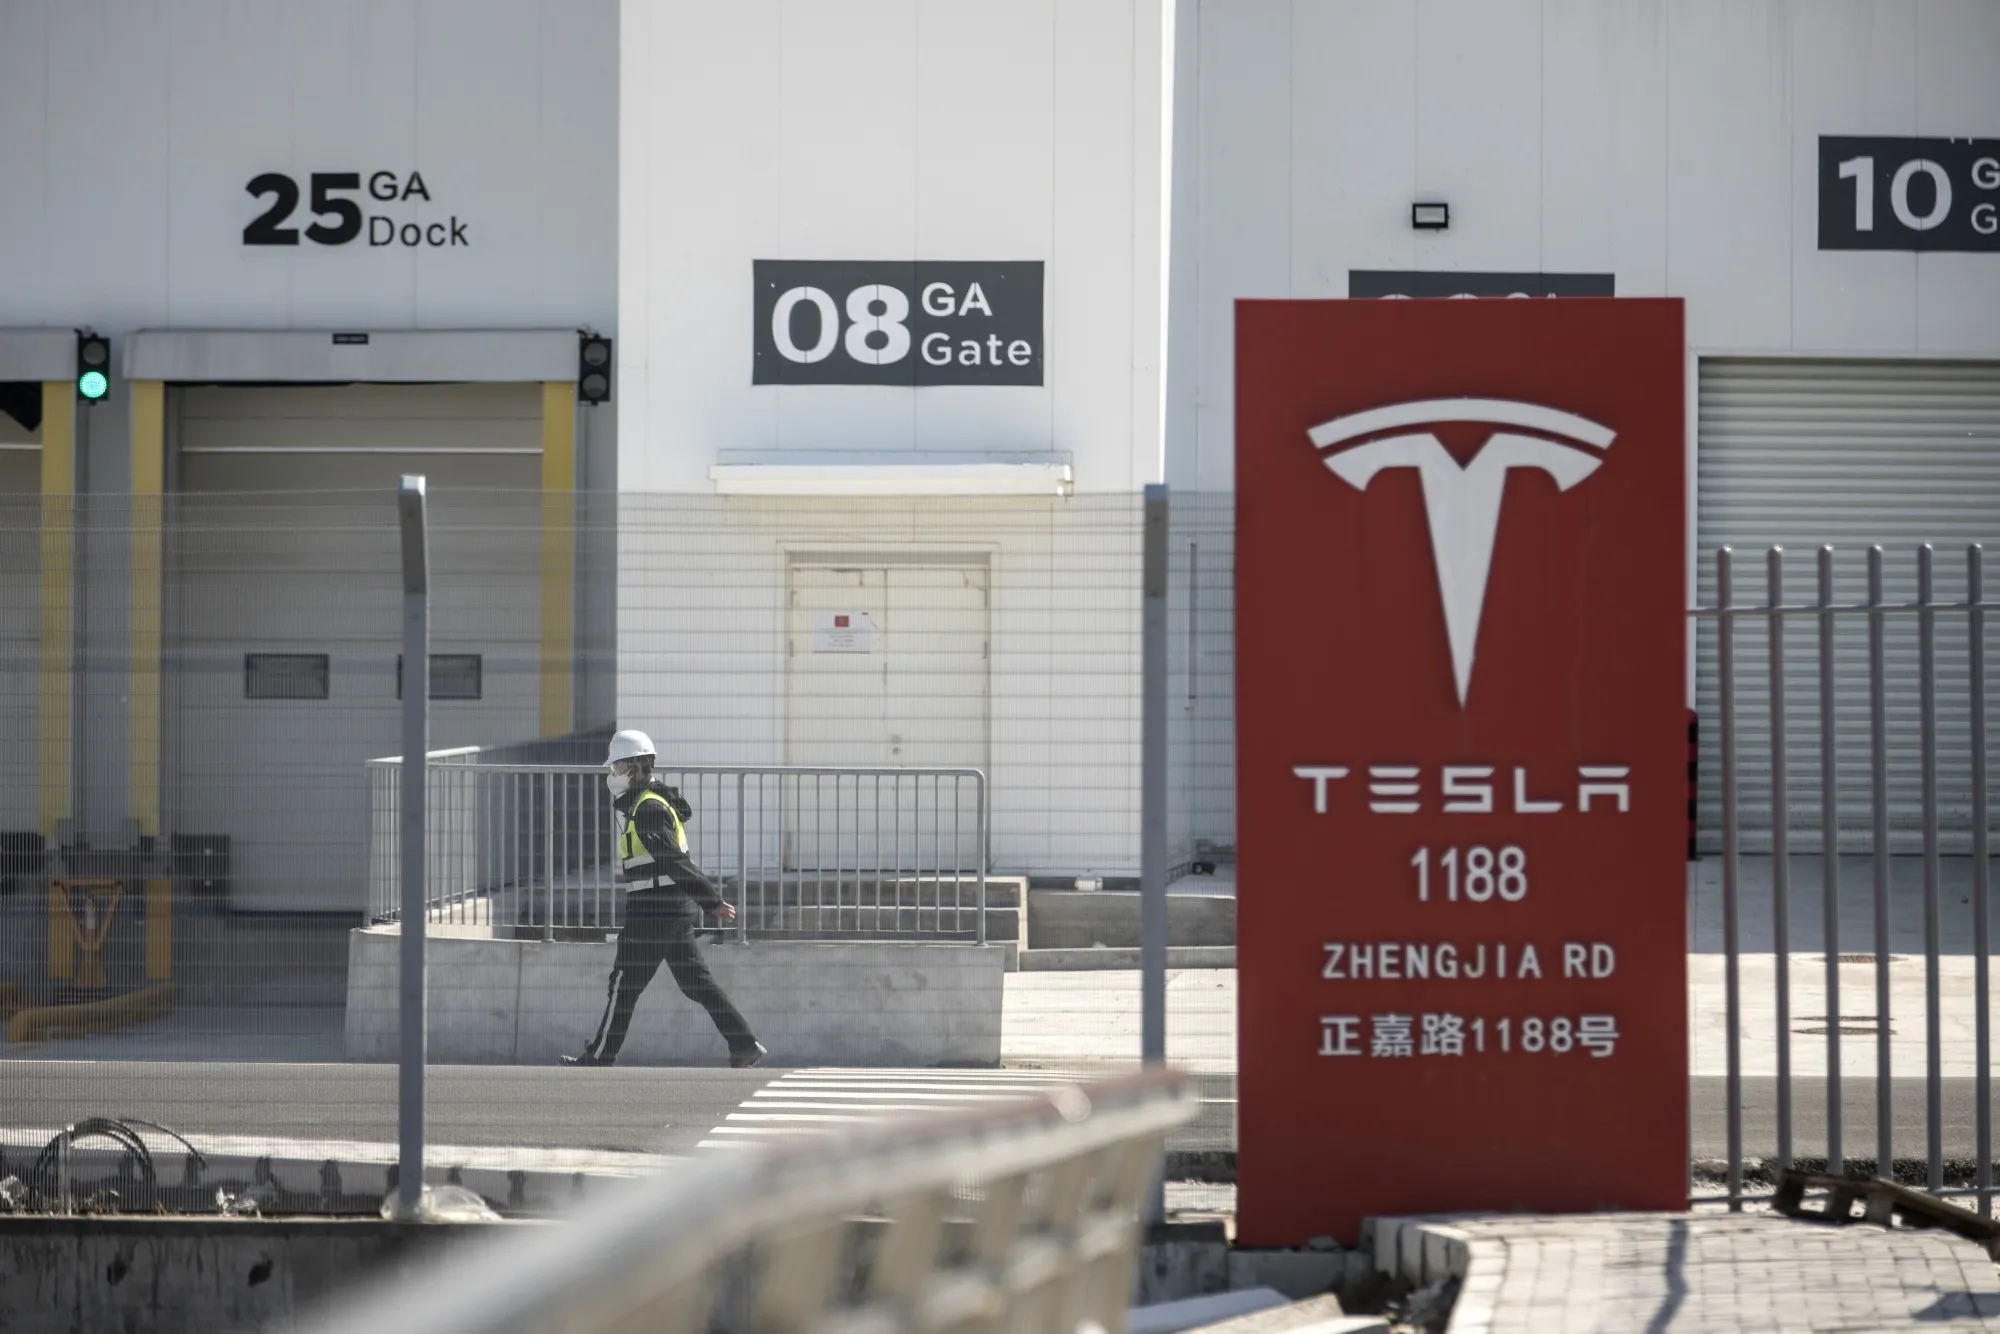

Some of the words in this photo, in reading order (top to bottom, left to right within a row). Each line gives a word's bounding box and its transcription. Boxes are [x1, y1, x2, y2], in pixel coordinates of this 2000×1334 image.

[368, 170, 431, 202] GA
[1971, 157, 2000, 190] G
[243, 173, 363, 246] 25
[1838, 156, 1953, 231] 10
[369, 215, 469, 247] Dock
[1970, 203, 1999, 235] G
[921, 282, 993, 317] GA
[771, 284, 911, 365] 08
[921, 332, 1032, 366] Gate
[1292, 765, 1630, 813] TESLA
[1411, 845, 1528, 902] 1188
[1322, 943, 1542, 979] ZHENGJIA
[1564, 943, 1616, 979] RD
[1318, 1012, 1620, 1058] 正嘉路1188号
